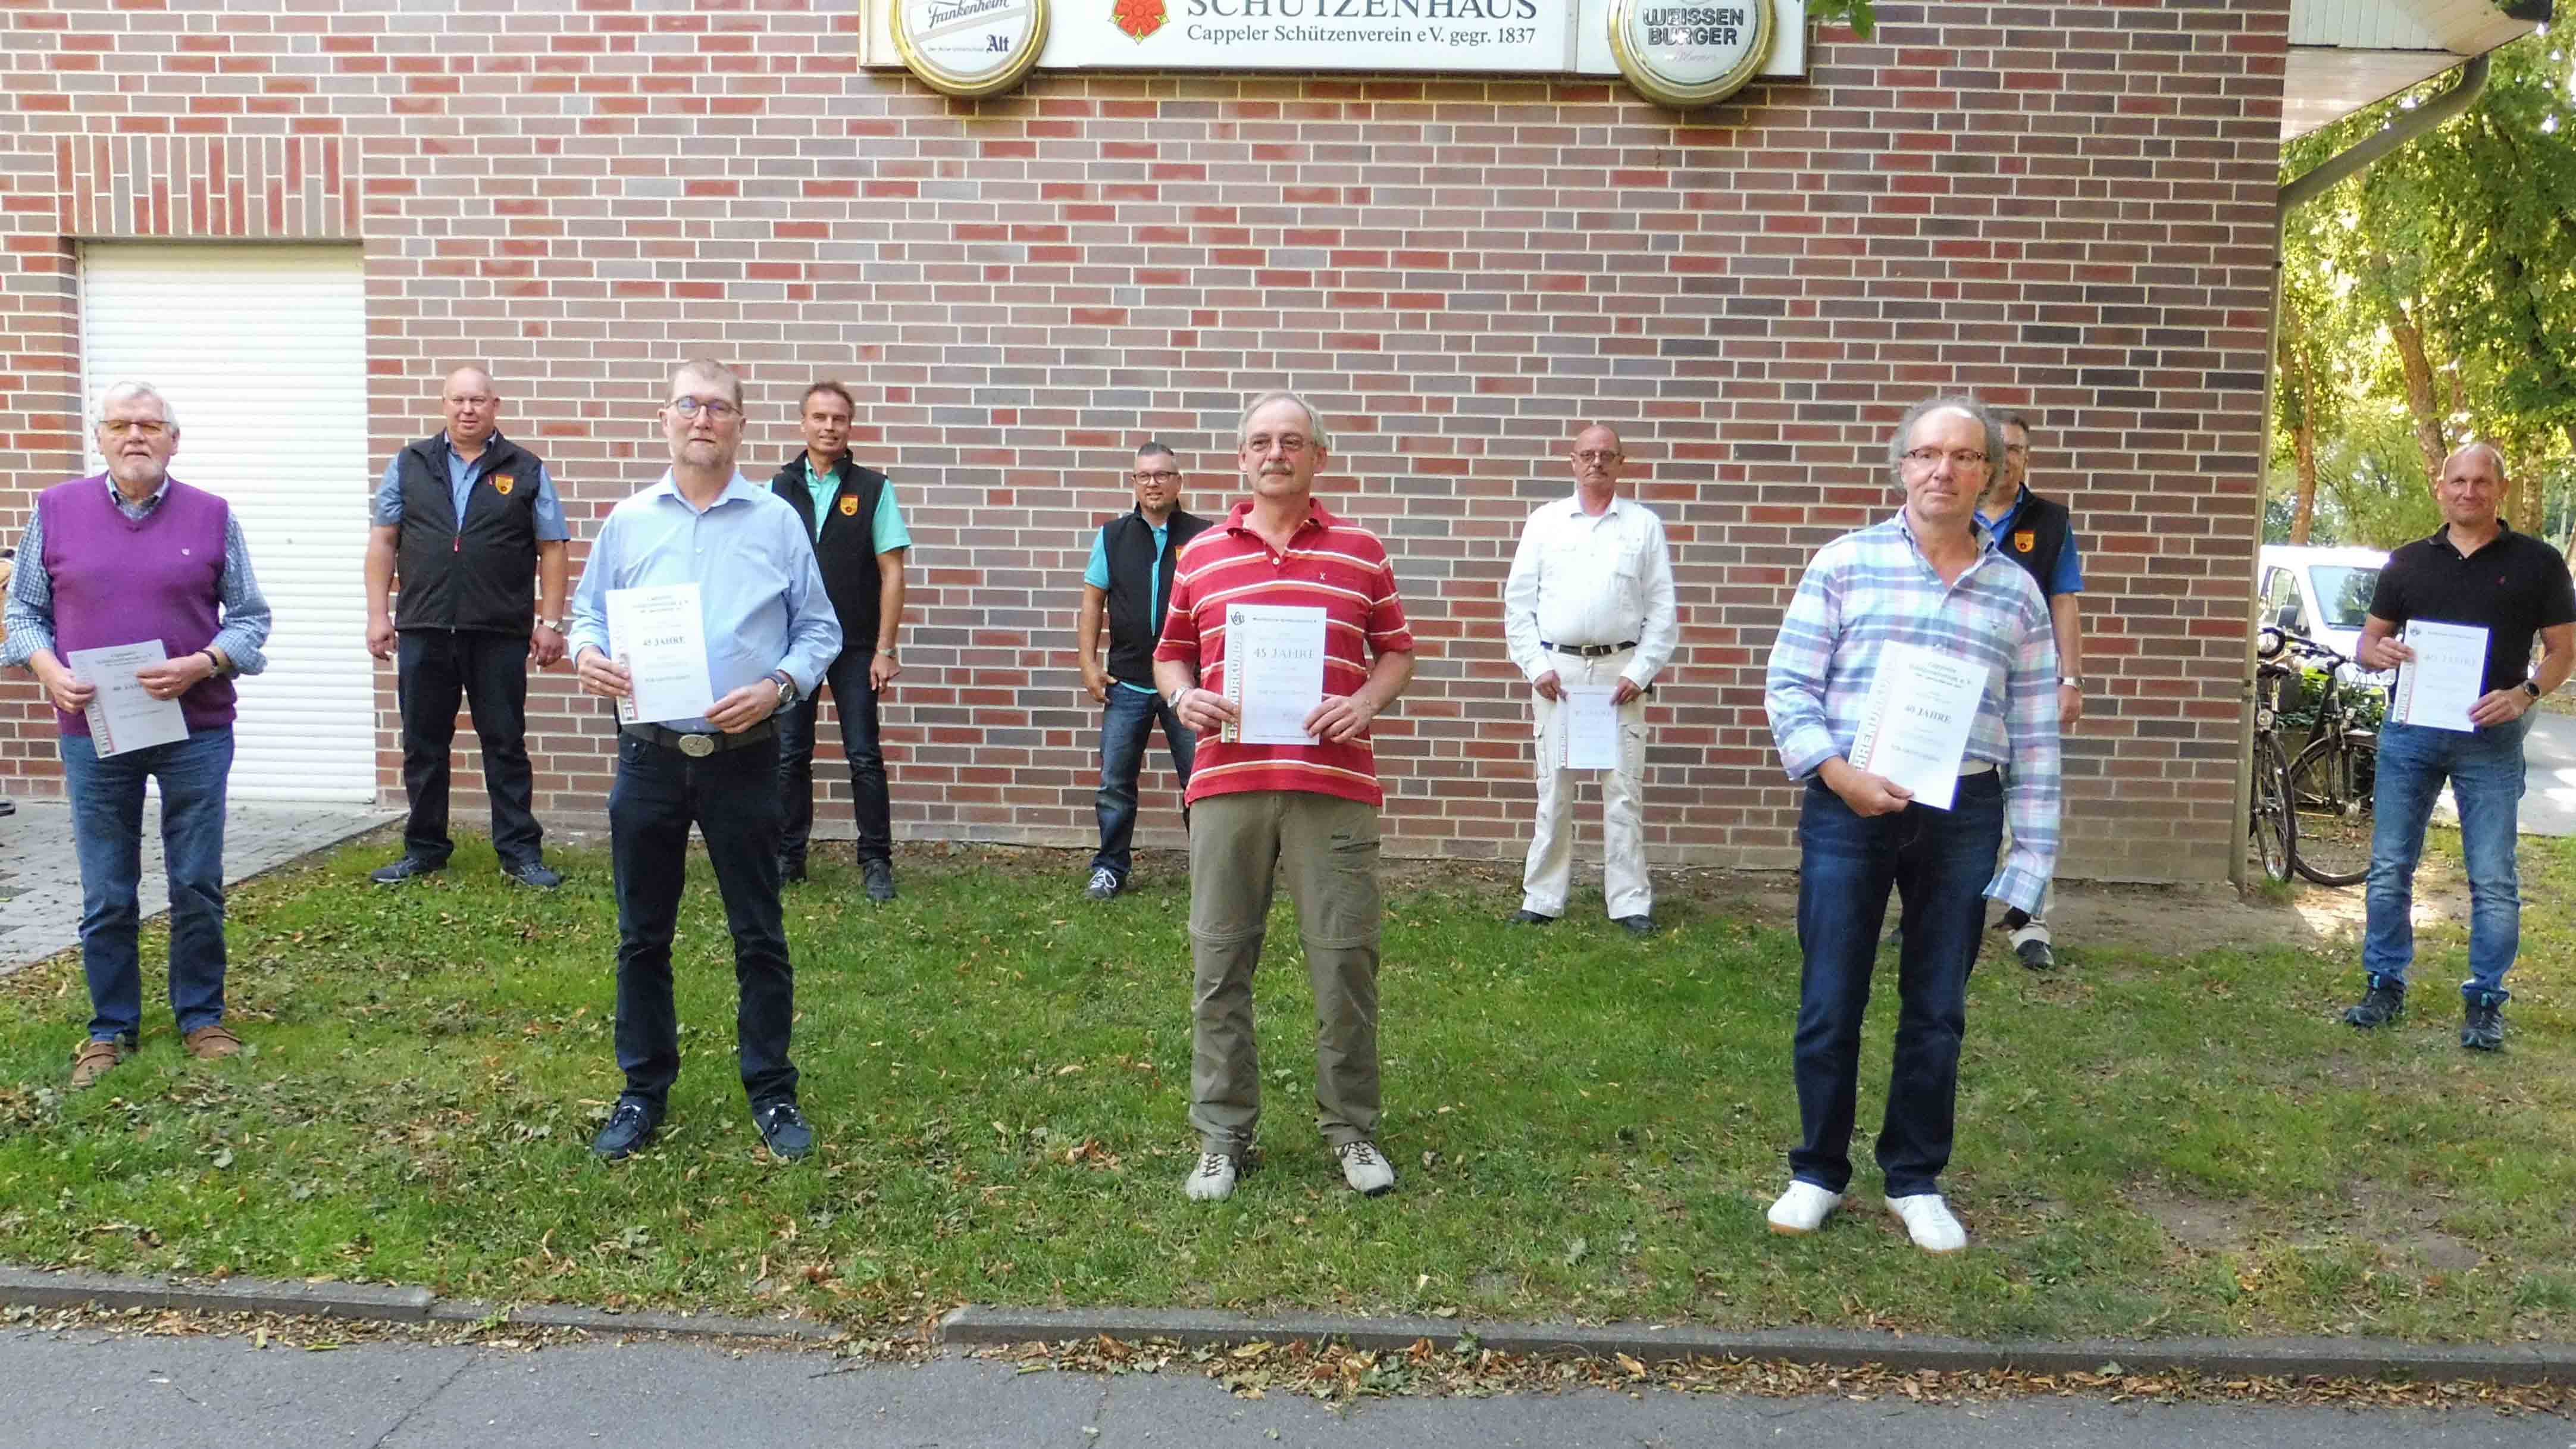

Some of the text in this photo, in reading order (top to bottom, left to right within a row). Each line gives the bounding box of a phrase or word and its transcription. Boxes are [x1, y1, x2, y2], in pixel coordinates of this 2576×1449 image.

[1643, 8, 1744, 26] WEISSEN
[986, 34, 1010, 54] Alt
[1187, 24, 1269, 45] Cappeler
[1274, 25, 1411, 42] Schützenverein
[1450, 30, 1491, 46] gegr.
[1497, 27, 1536, 43] 1837
[1648, 27, 1738, 45] BURGER
